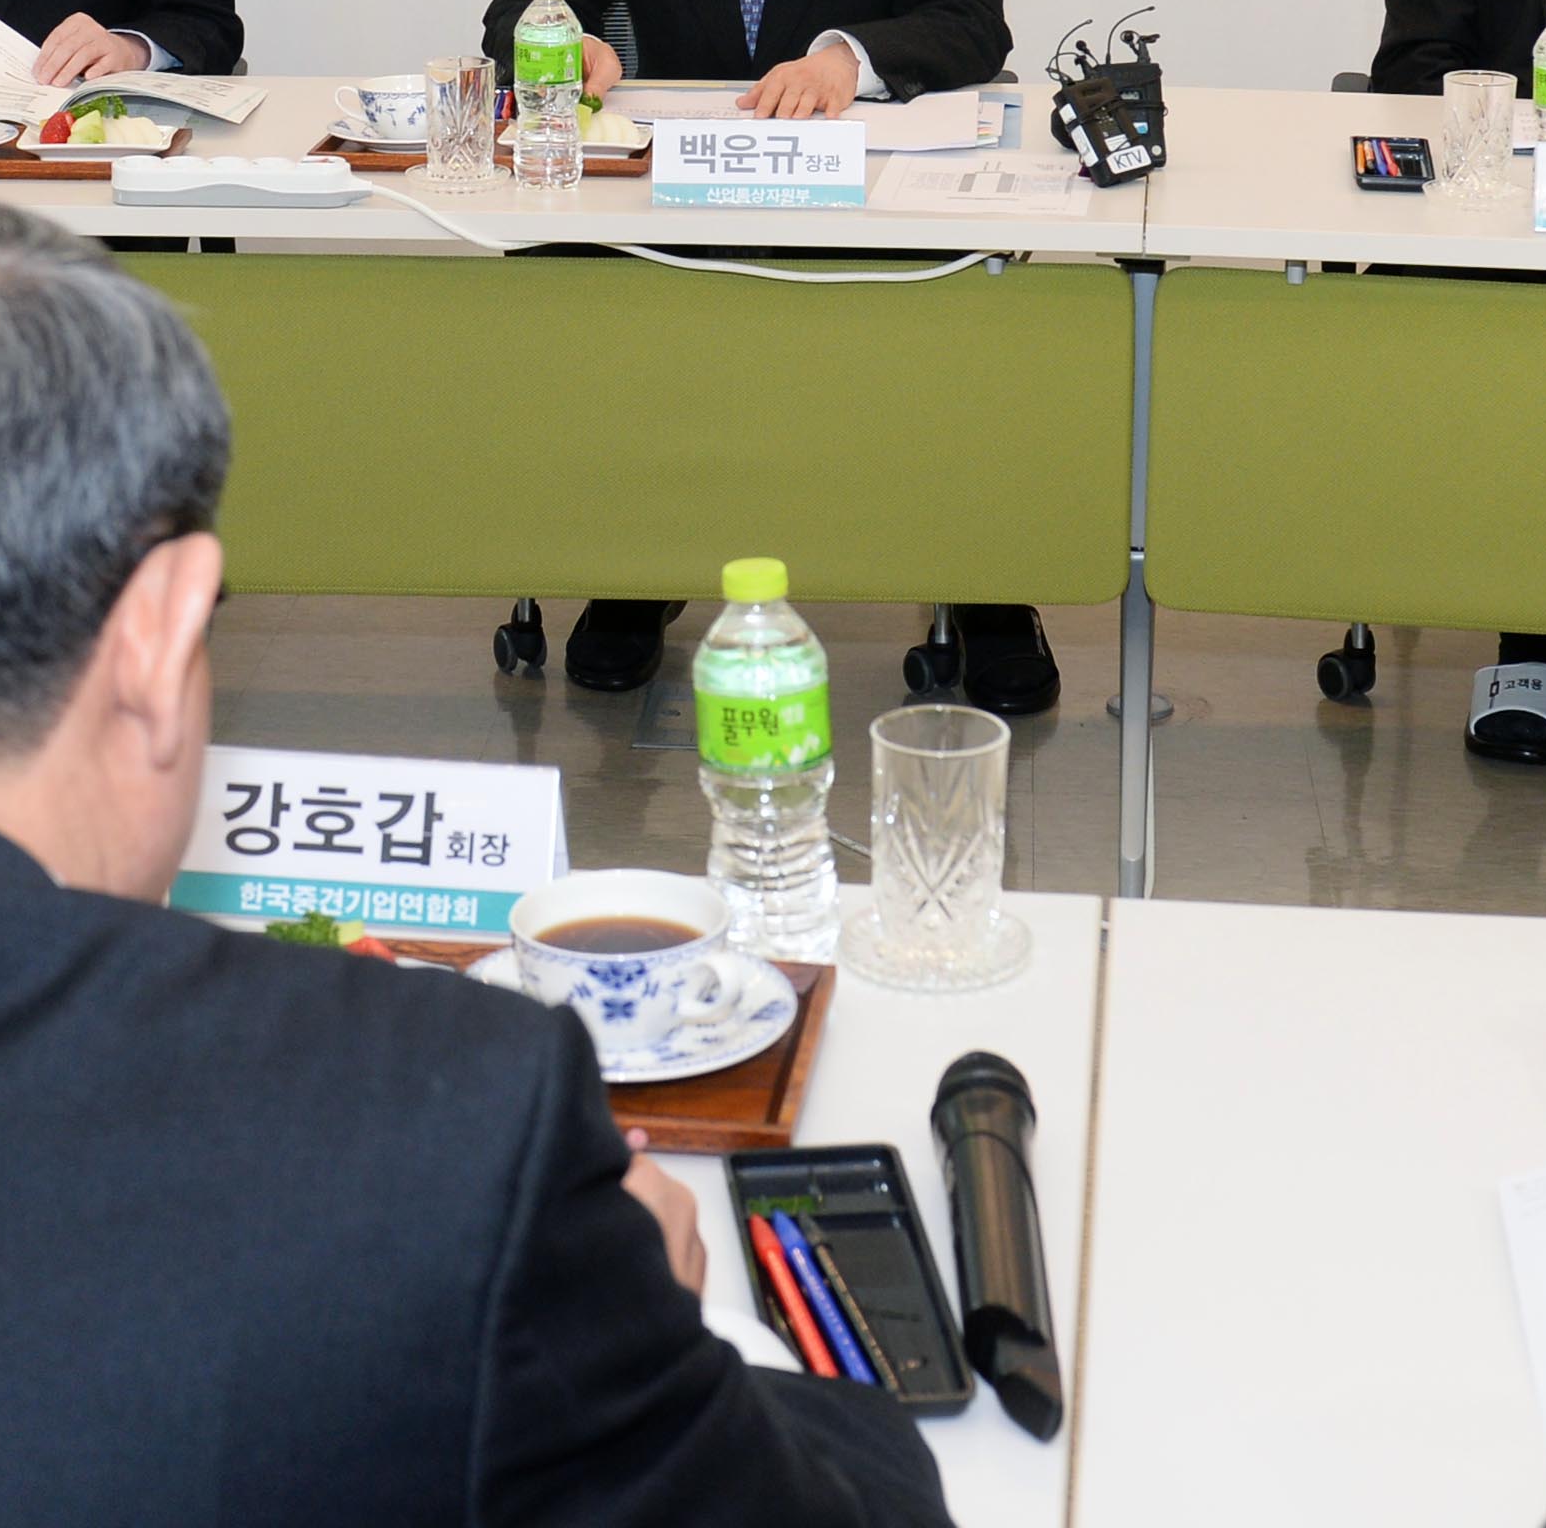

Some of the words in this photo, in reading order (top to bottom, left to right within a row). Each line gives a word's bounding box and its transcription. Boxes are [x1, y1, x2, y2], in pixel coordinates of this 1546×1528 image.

[679, 133, 803, 175] 백운규
[805, 153, 842, 173] 장관
[1113, 149, 1143, 170] KTV
[706, 186, 811, 205] 산업통상자원부
[1504, 677, 1544, 691] 고객용
[720, 706, 780, 748] 풀무원
[222, 781, 445, 867] 강호갑
[445, 830, 512, 868] 회장
[239, 881, 480, 927] 한국중견기업연합회
